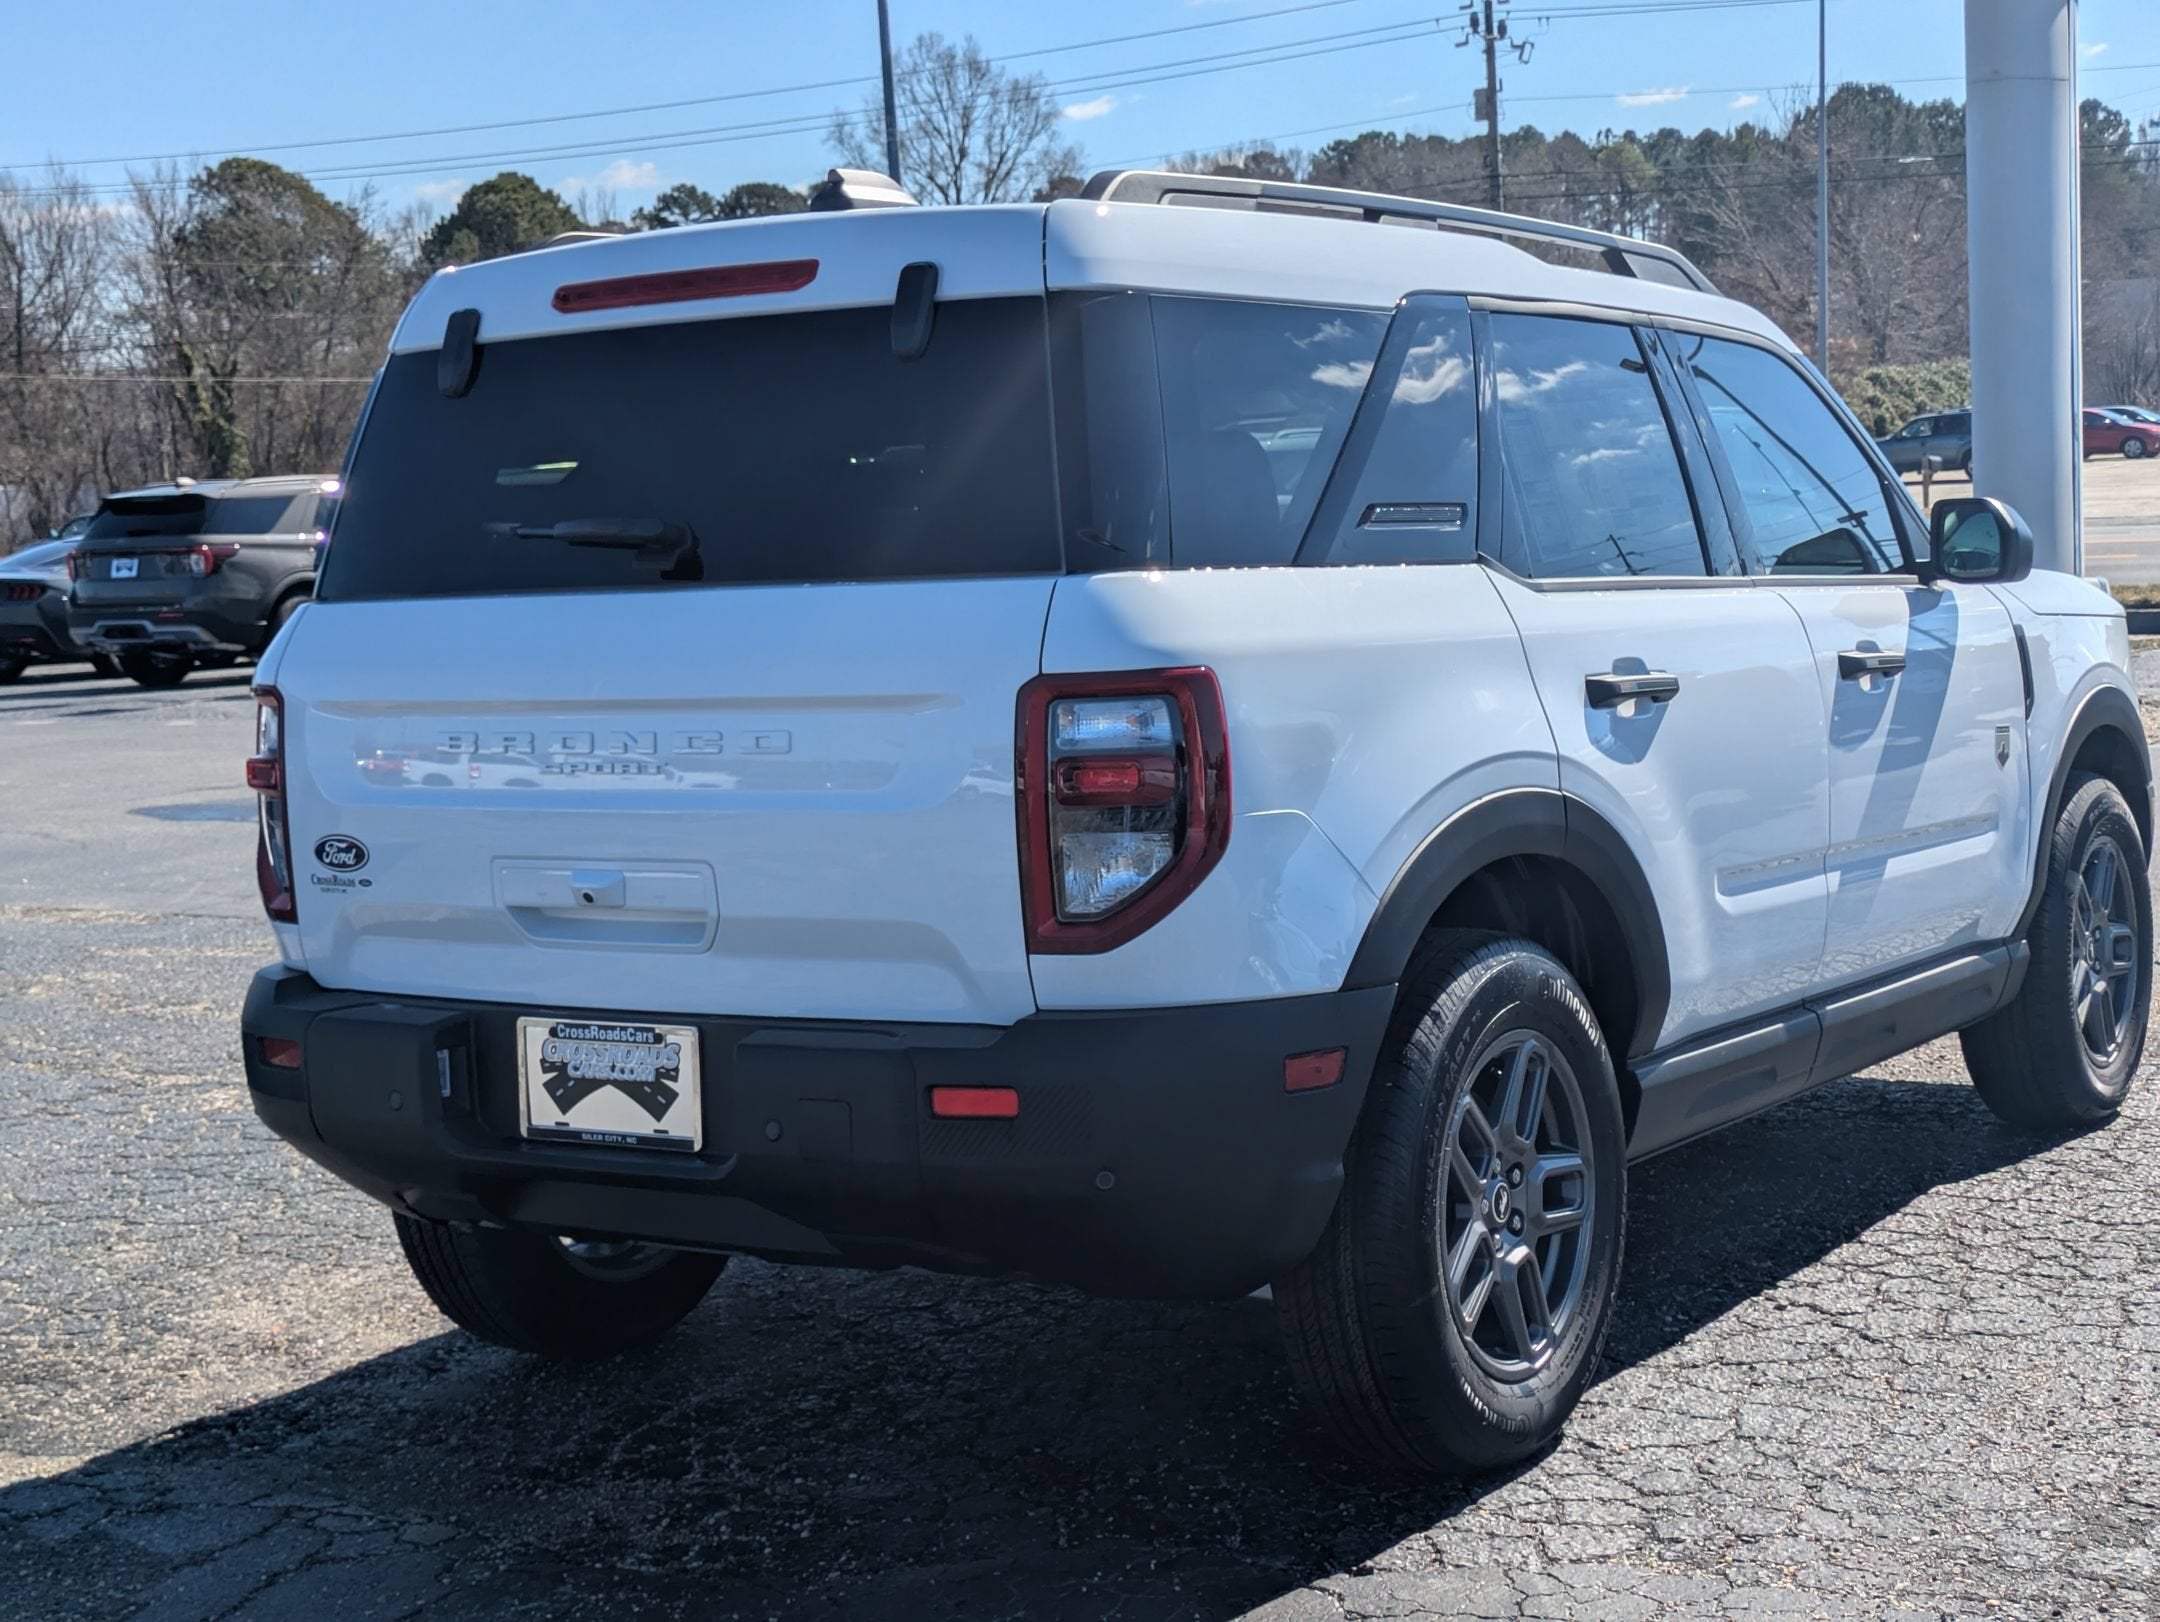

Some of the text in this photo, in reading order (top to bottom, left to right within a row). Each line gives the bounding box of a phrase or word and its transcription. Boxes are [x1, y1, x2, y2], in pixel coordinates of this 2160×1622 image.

[437, 730, 793, 755] BRONCO
[541, 760, 670, 775] SPORT
[322, 841, 357, 864] Ford
[556, 1023, 655, 1043] CrossRoadsCars
[542, 1038, 681, 1070] CROSSROADS
[626, 1136, 638, 1145] NC
